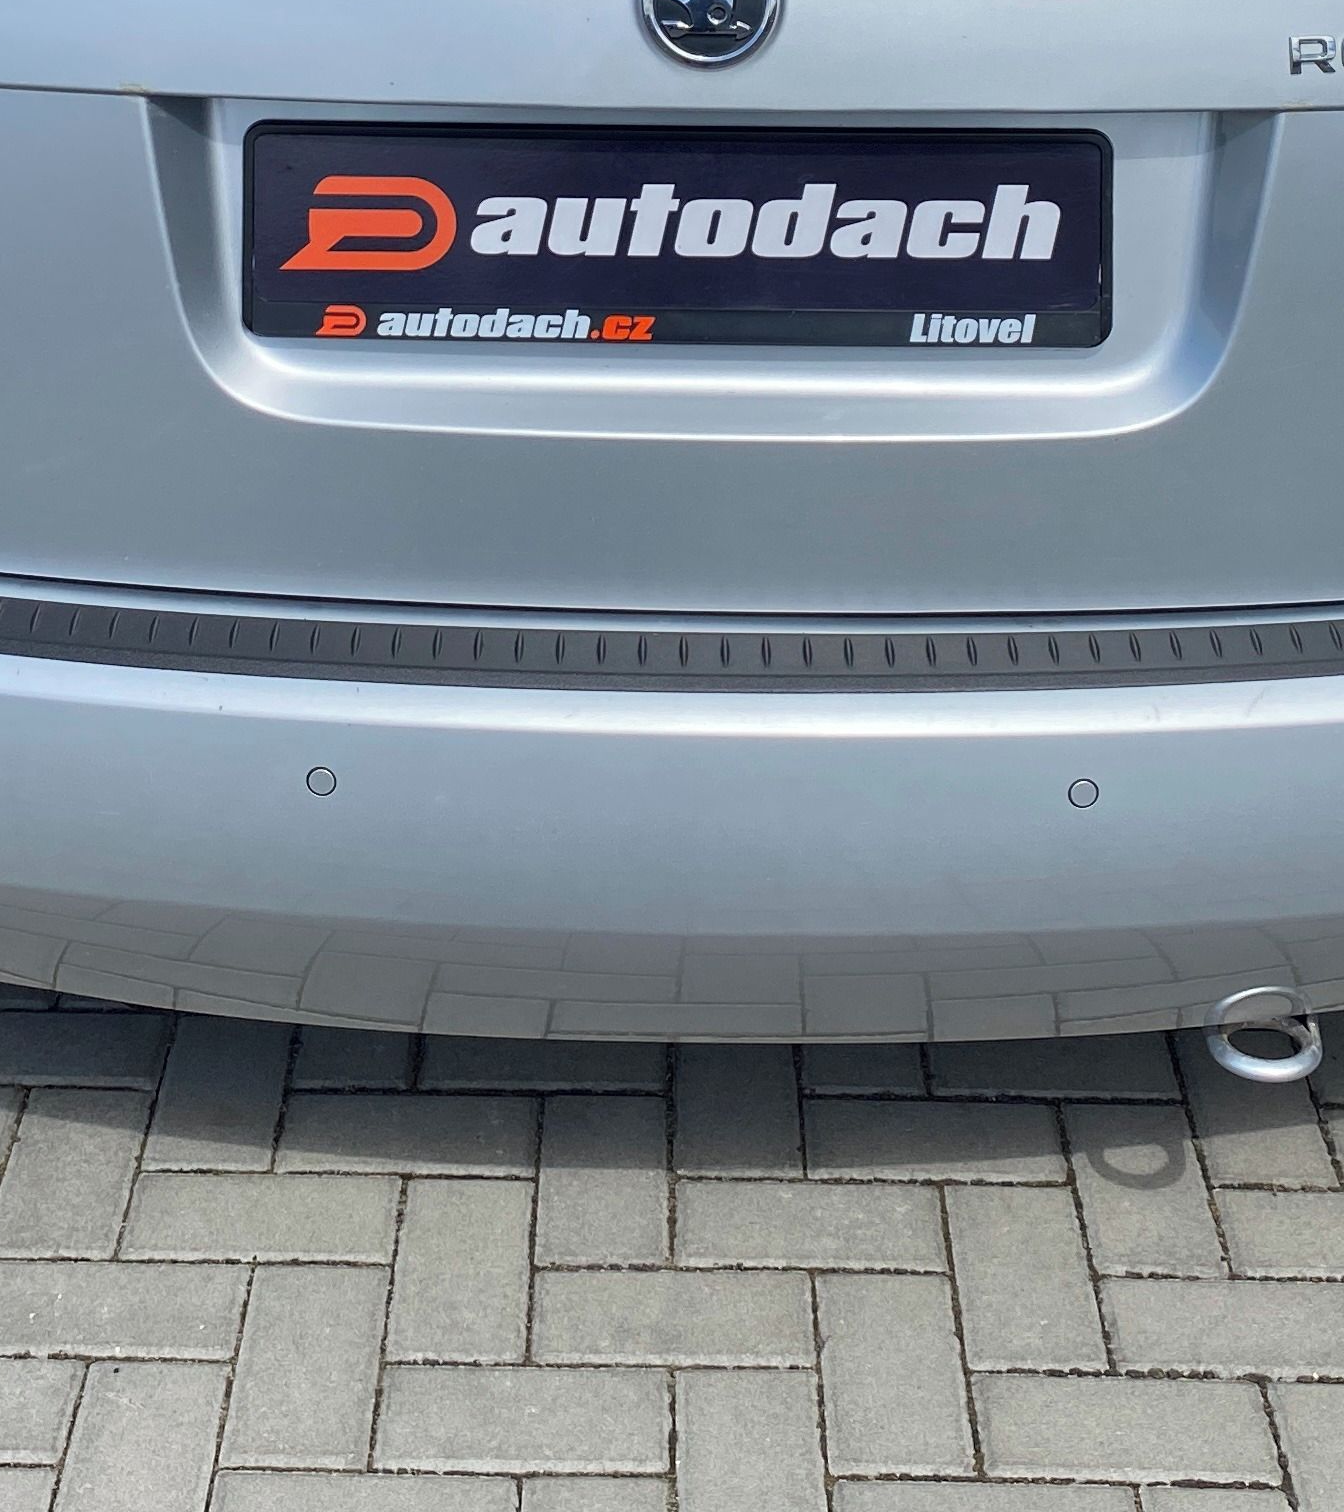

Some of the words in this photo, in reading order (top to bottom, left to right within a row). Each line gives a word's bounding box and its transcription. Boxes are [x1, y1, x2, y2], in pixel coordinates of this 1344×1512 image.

[470, 182, 1063, 261] autodach
[376, 307, 657, 341] autodach.cz
[909, 313, 1037, 344] Litovel
